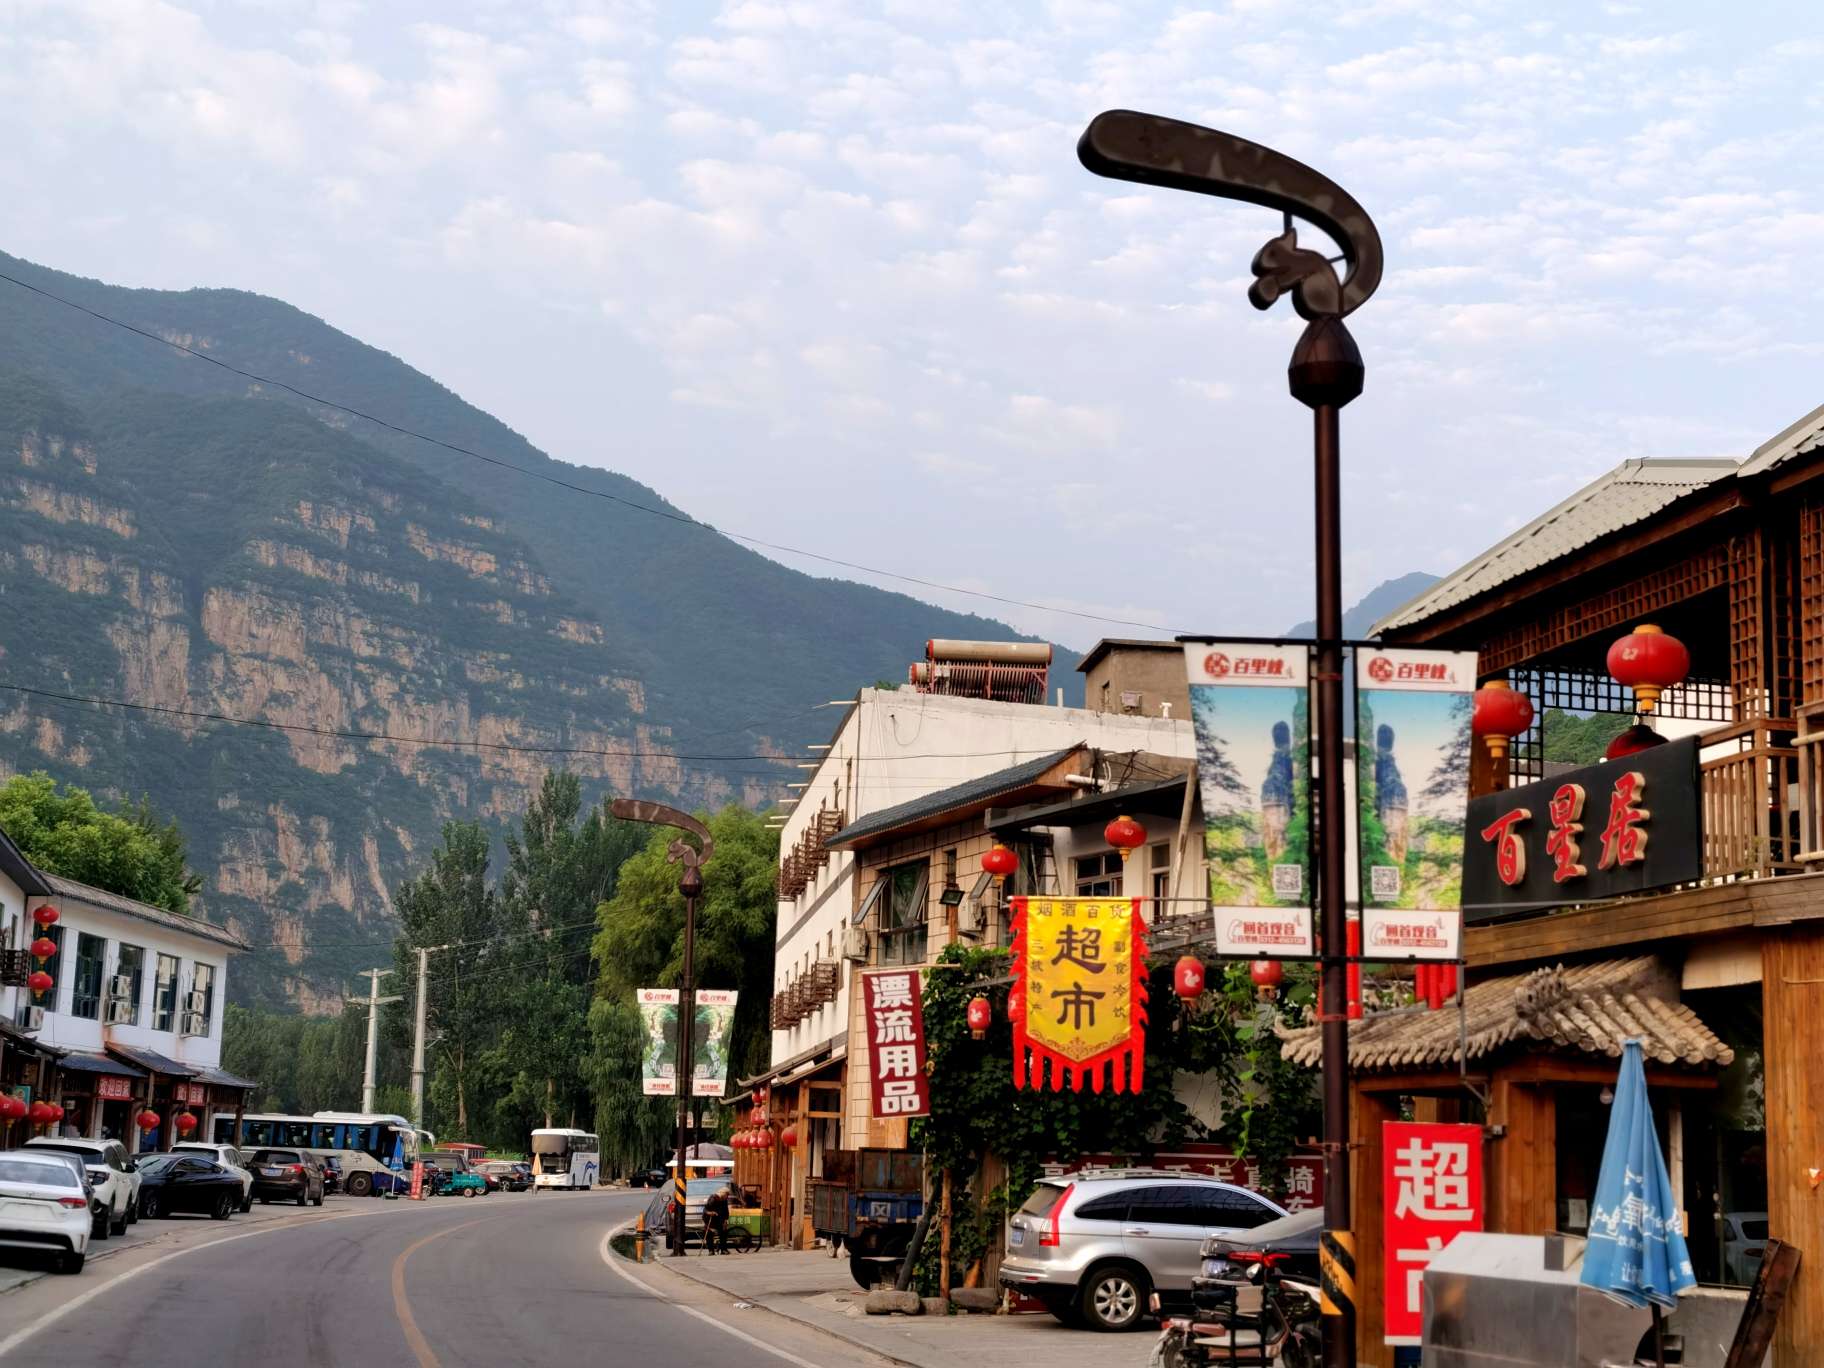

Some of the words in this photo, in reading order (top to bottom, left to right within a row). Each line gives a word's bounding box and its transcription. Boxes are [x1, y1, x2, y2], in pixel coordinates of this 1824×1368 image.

[1233, 657, 1284, 675] 百里峡
[1397, 662, 1447, 679] 百里峡
[1037, 902, 1125, 919] 烟酒百货
[1050, 924, 1107, 1030] 超市
[1113, 940, 1127, 1018] 副食冷饮
[870, 974, 920, 1114] 漂流用品
